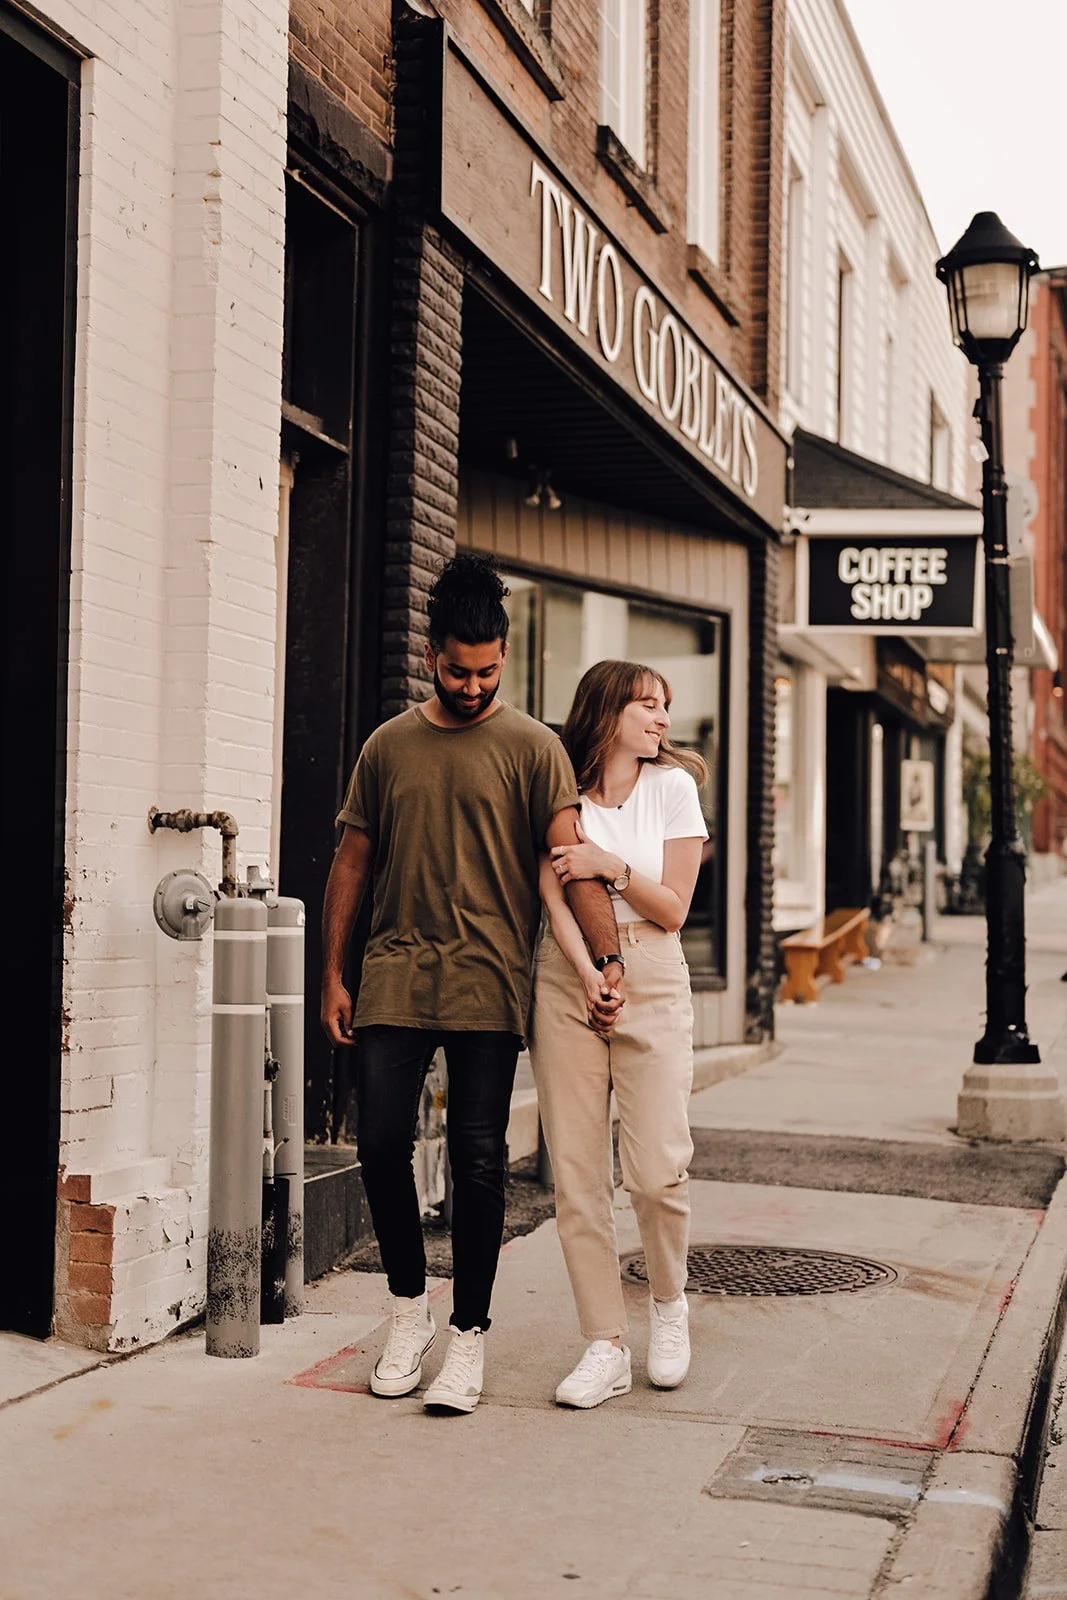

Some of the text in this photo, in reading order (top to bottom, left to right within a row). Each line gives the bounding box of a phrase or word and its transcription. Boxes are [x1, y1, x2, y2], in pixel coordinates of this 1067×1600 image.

[530, 160, 758, 497] TWO GOBLETS
[838, 547, 948, 584] COFFEE
[850, 583, 933, 621] SHOP
